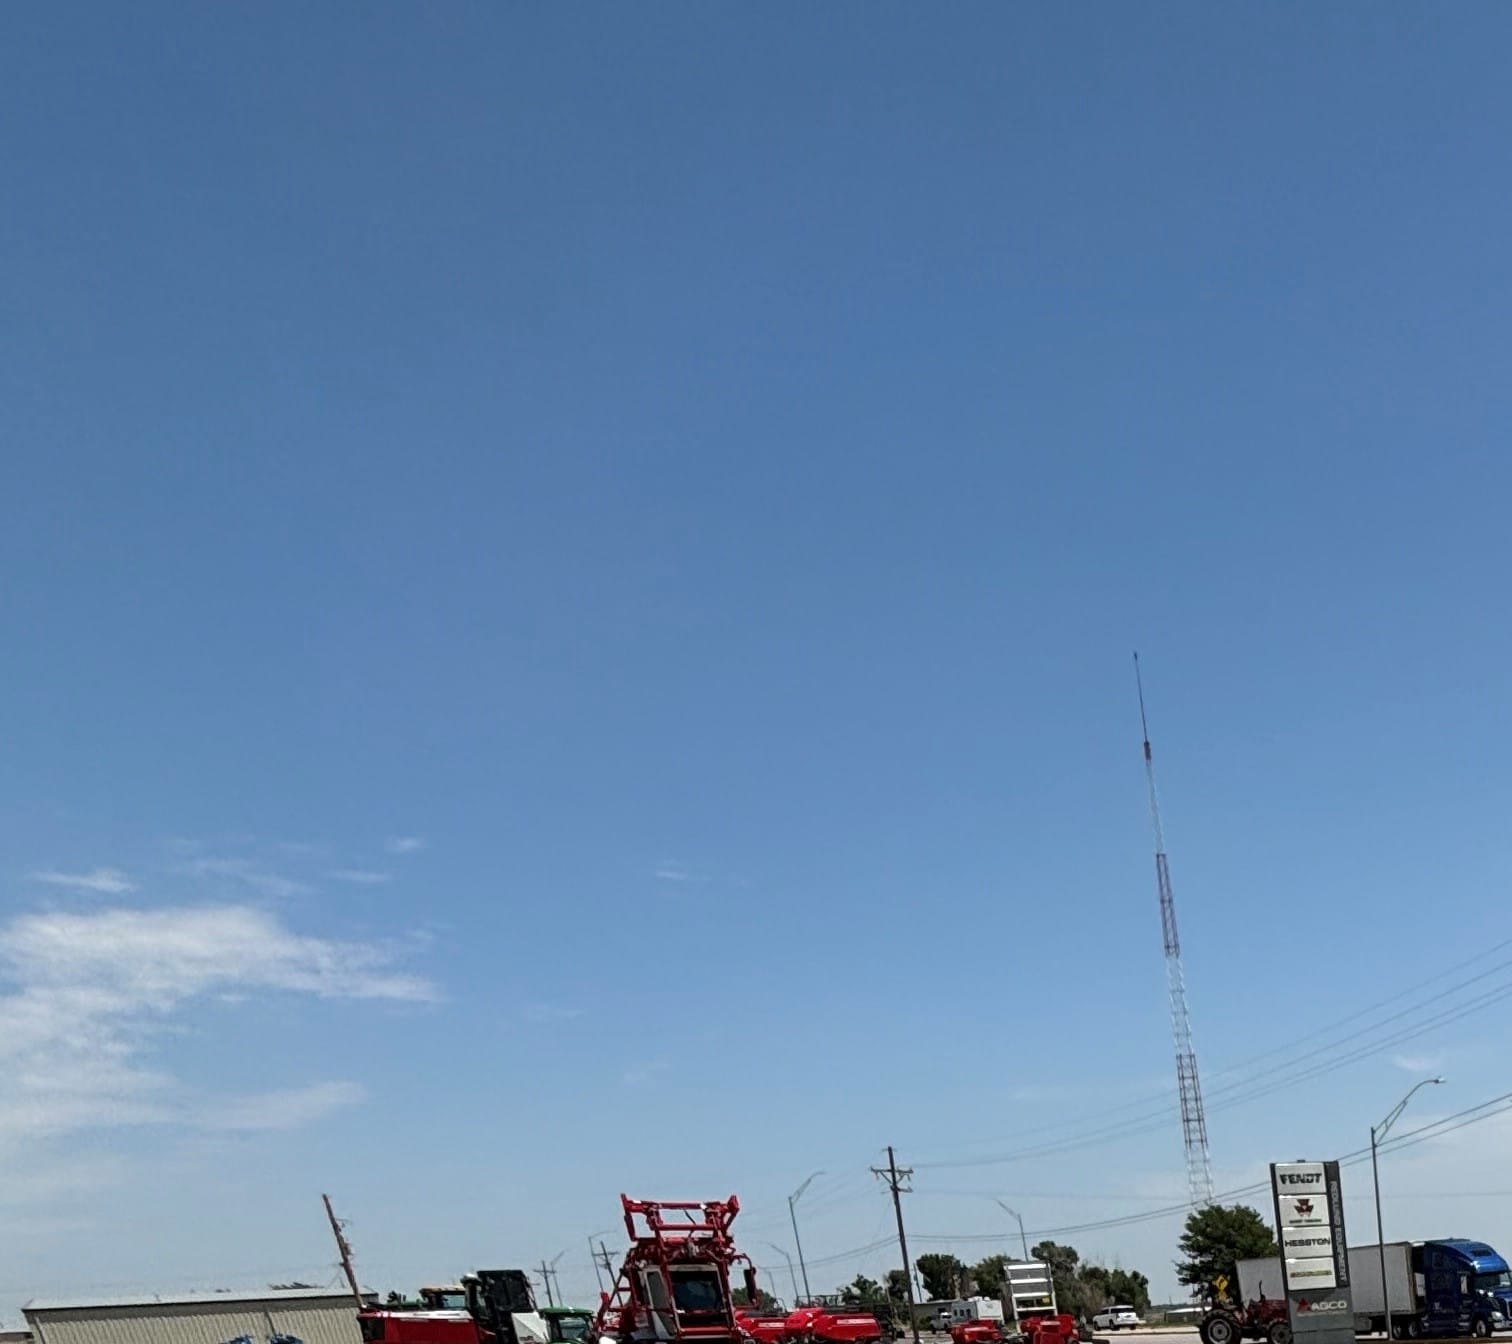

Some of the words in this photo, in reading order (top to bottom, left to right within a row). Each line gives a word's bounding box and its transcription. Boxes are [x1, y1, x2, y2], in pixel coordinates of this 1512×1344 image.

[1279, 1173, 1322, 1185] FENDT
[1284, 1237, 1331, 1248] HESSTON
[1311, 1301, 1348, 1312] AGCO
